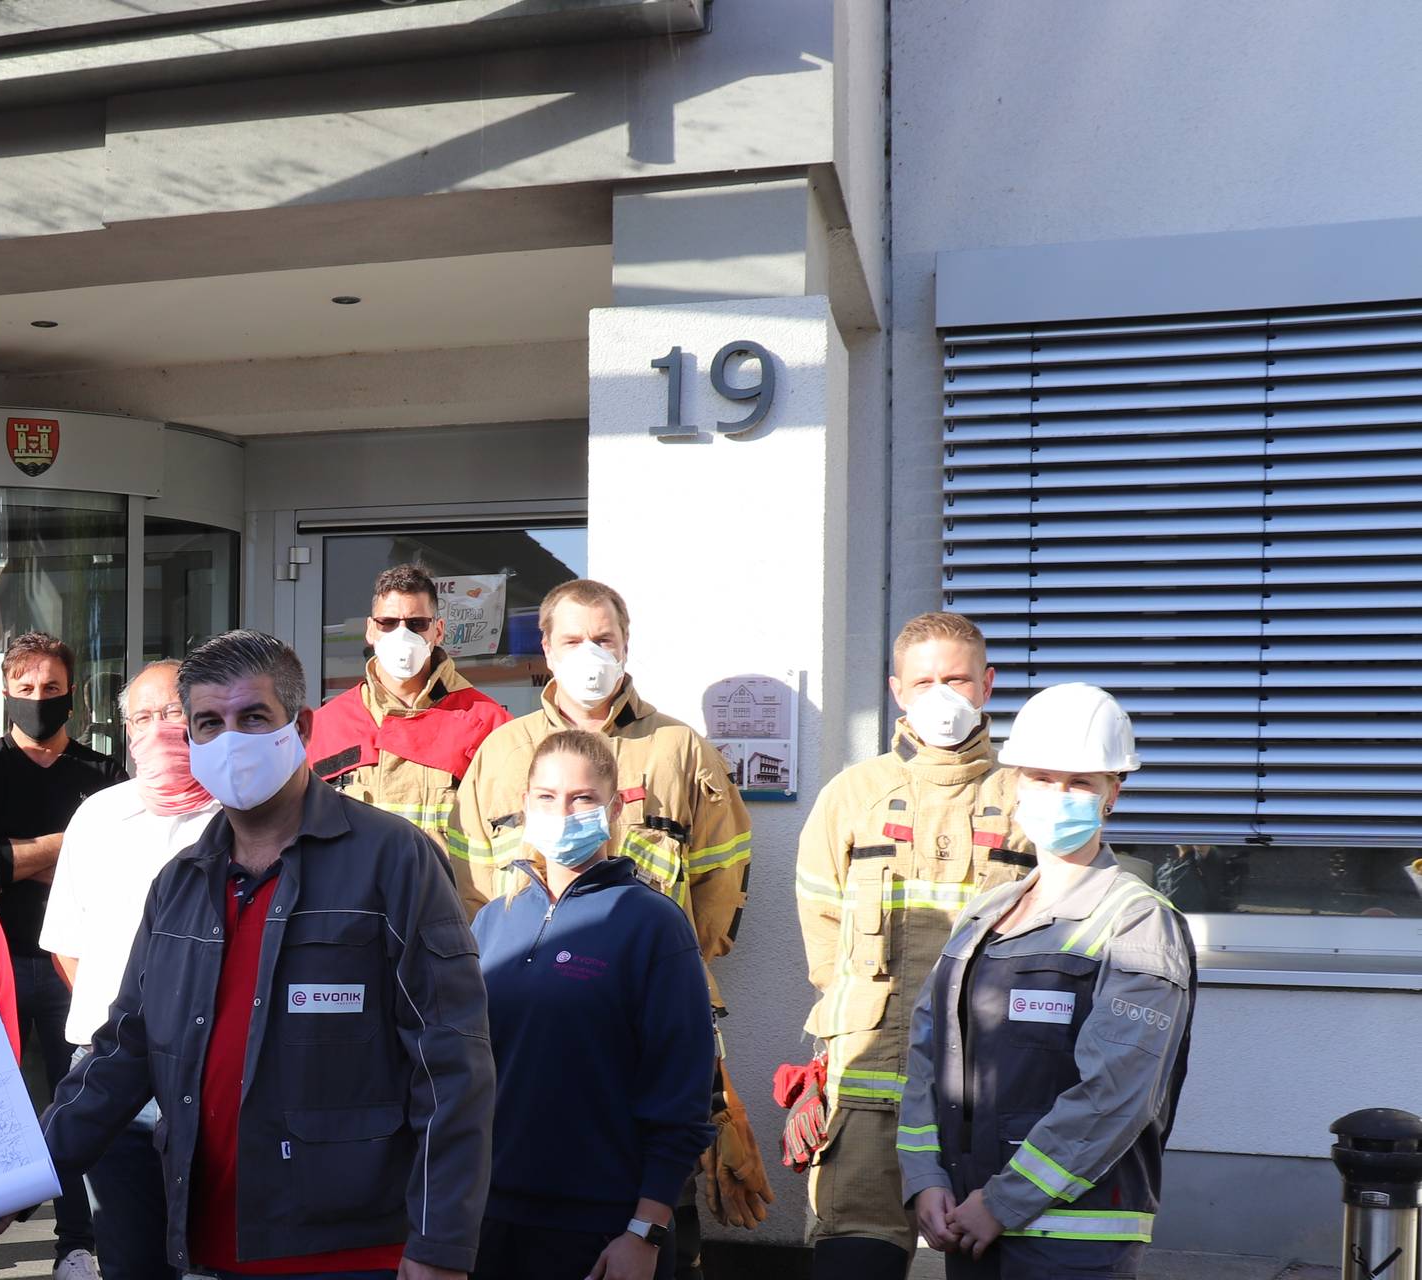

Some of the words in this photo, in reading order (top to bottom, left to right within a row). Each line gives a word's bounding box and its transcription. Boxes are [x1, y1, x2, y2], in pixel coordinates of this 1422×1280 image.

[649, 340, 776, 436] 19
[313, 992, 361, 1002] EVONIK
[1029, 1001, 1074, 1013] EVONIK
